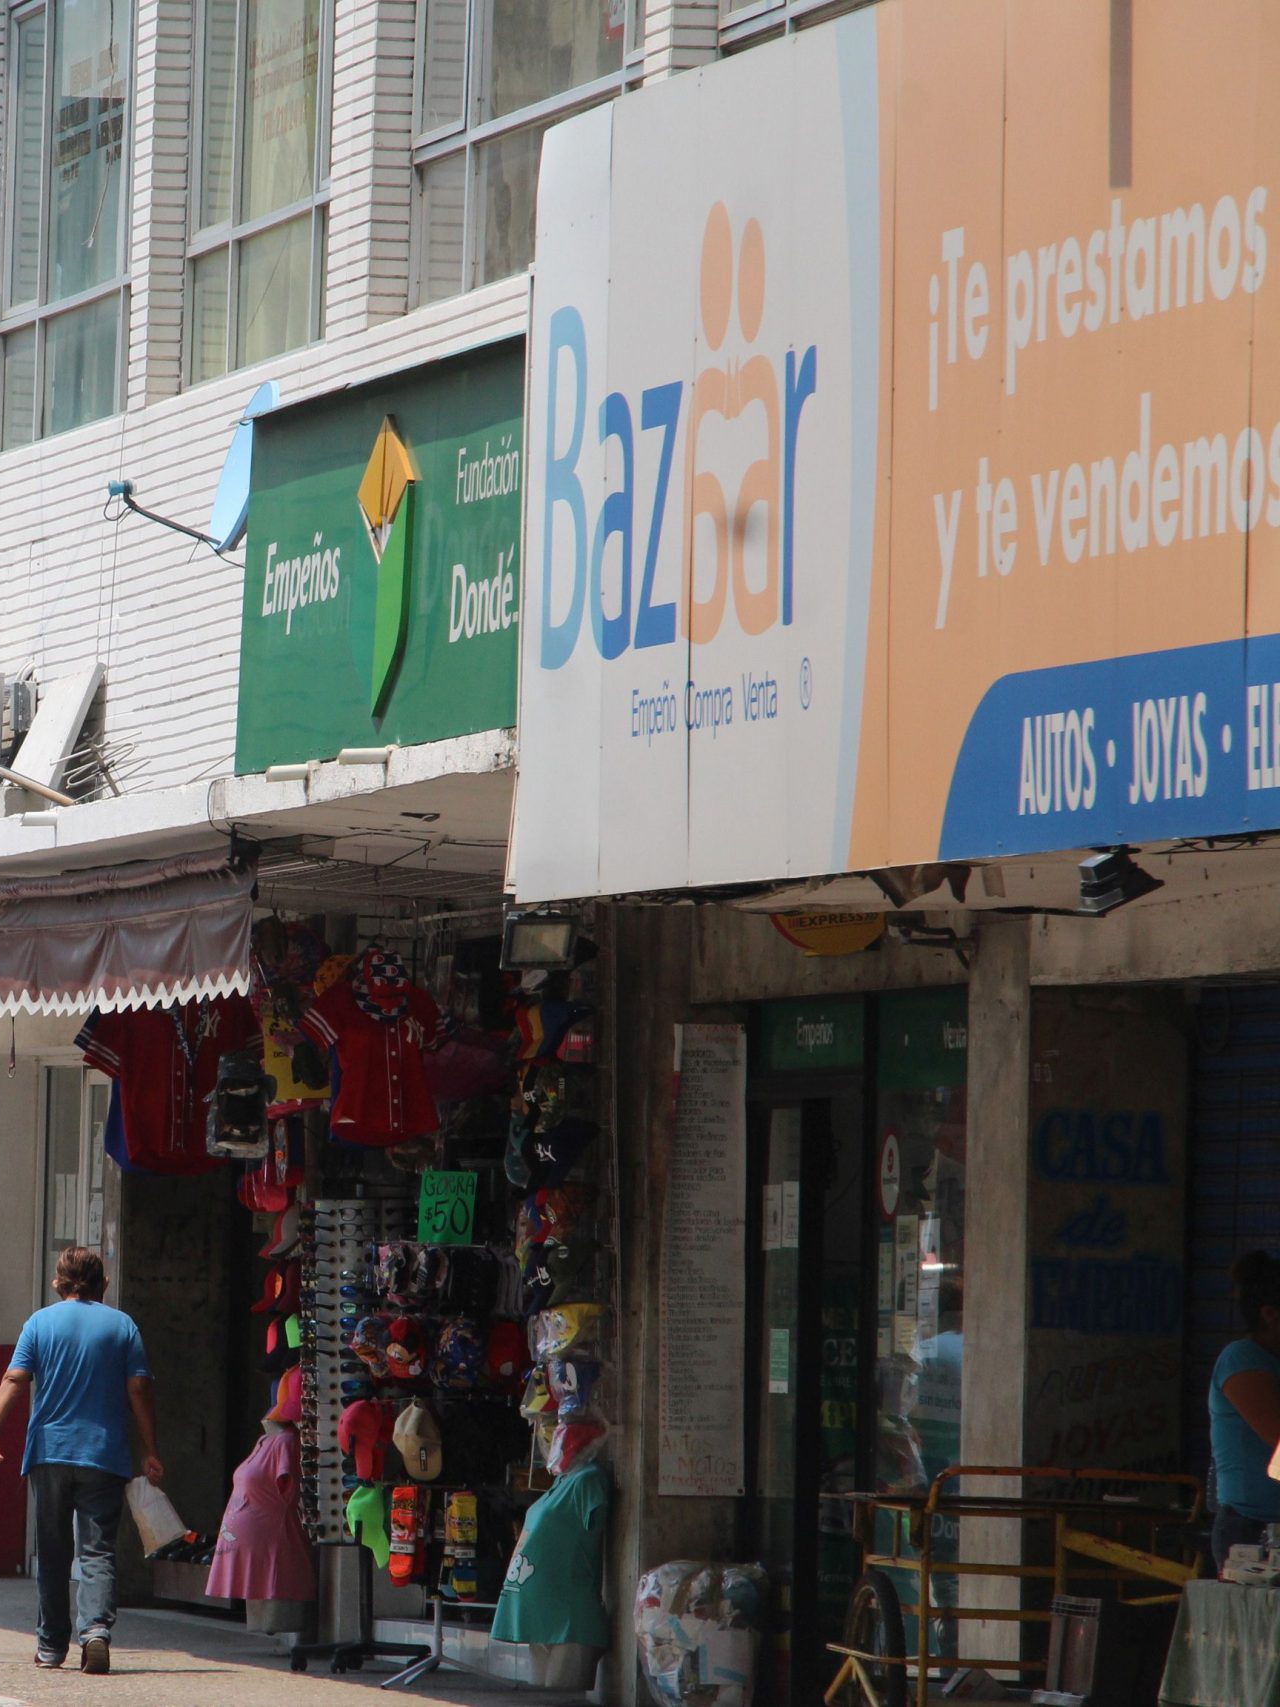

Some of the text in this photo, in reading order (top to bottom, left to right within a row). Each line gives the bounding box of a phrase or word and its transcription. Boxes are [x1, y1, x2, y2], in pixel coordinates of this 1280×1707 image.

[928, 185, 1268, 412] ¡Te prestamos
[456, 433, 520, 505] Fundación
[539, 305, 817, 671] Bazar
[933, 489, 963, 630] y
[975, 456, 1019, 578] te
[261, 531, 341, 636] Empeños
[631, 671, 778, 748] Empeño Compra Venta
[1018, 706, 1097, 816] AUTOS
[1129, 691, 1208, 805] JOYAS
[798, 911, 865, 928] EXPRESS
[796, 1016, 834, 1052] Empeños
[1033, 1109, 1170, 1186] CASA
[424, 1197, 471, 1236] $50
